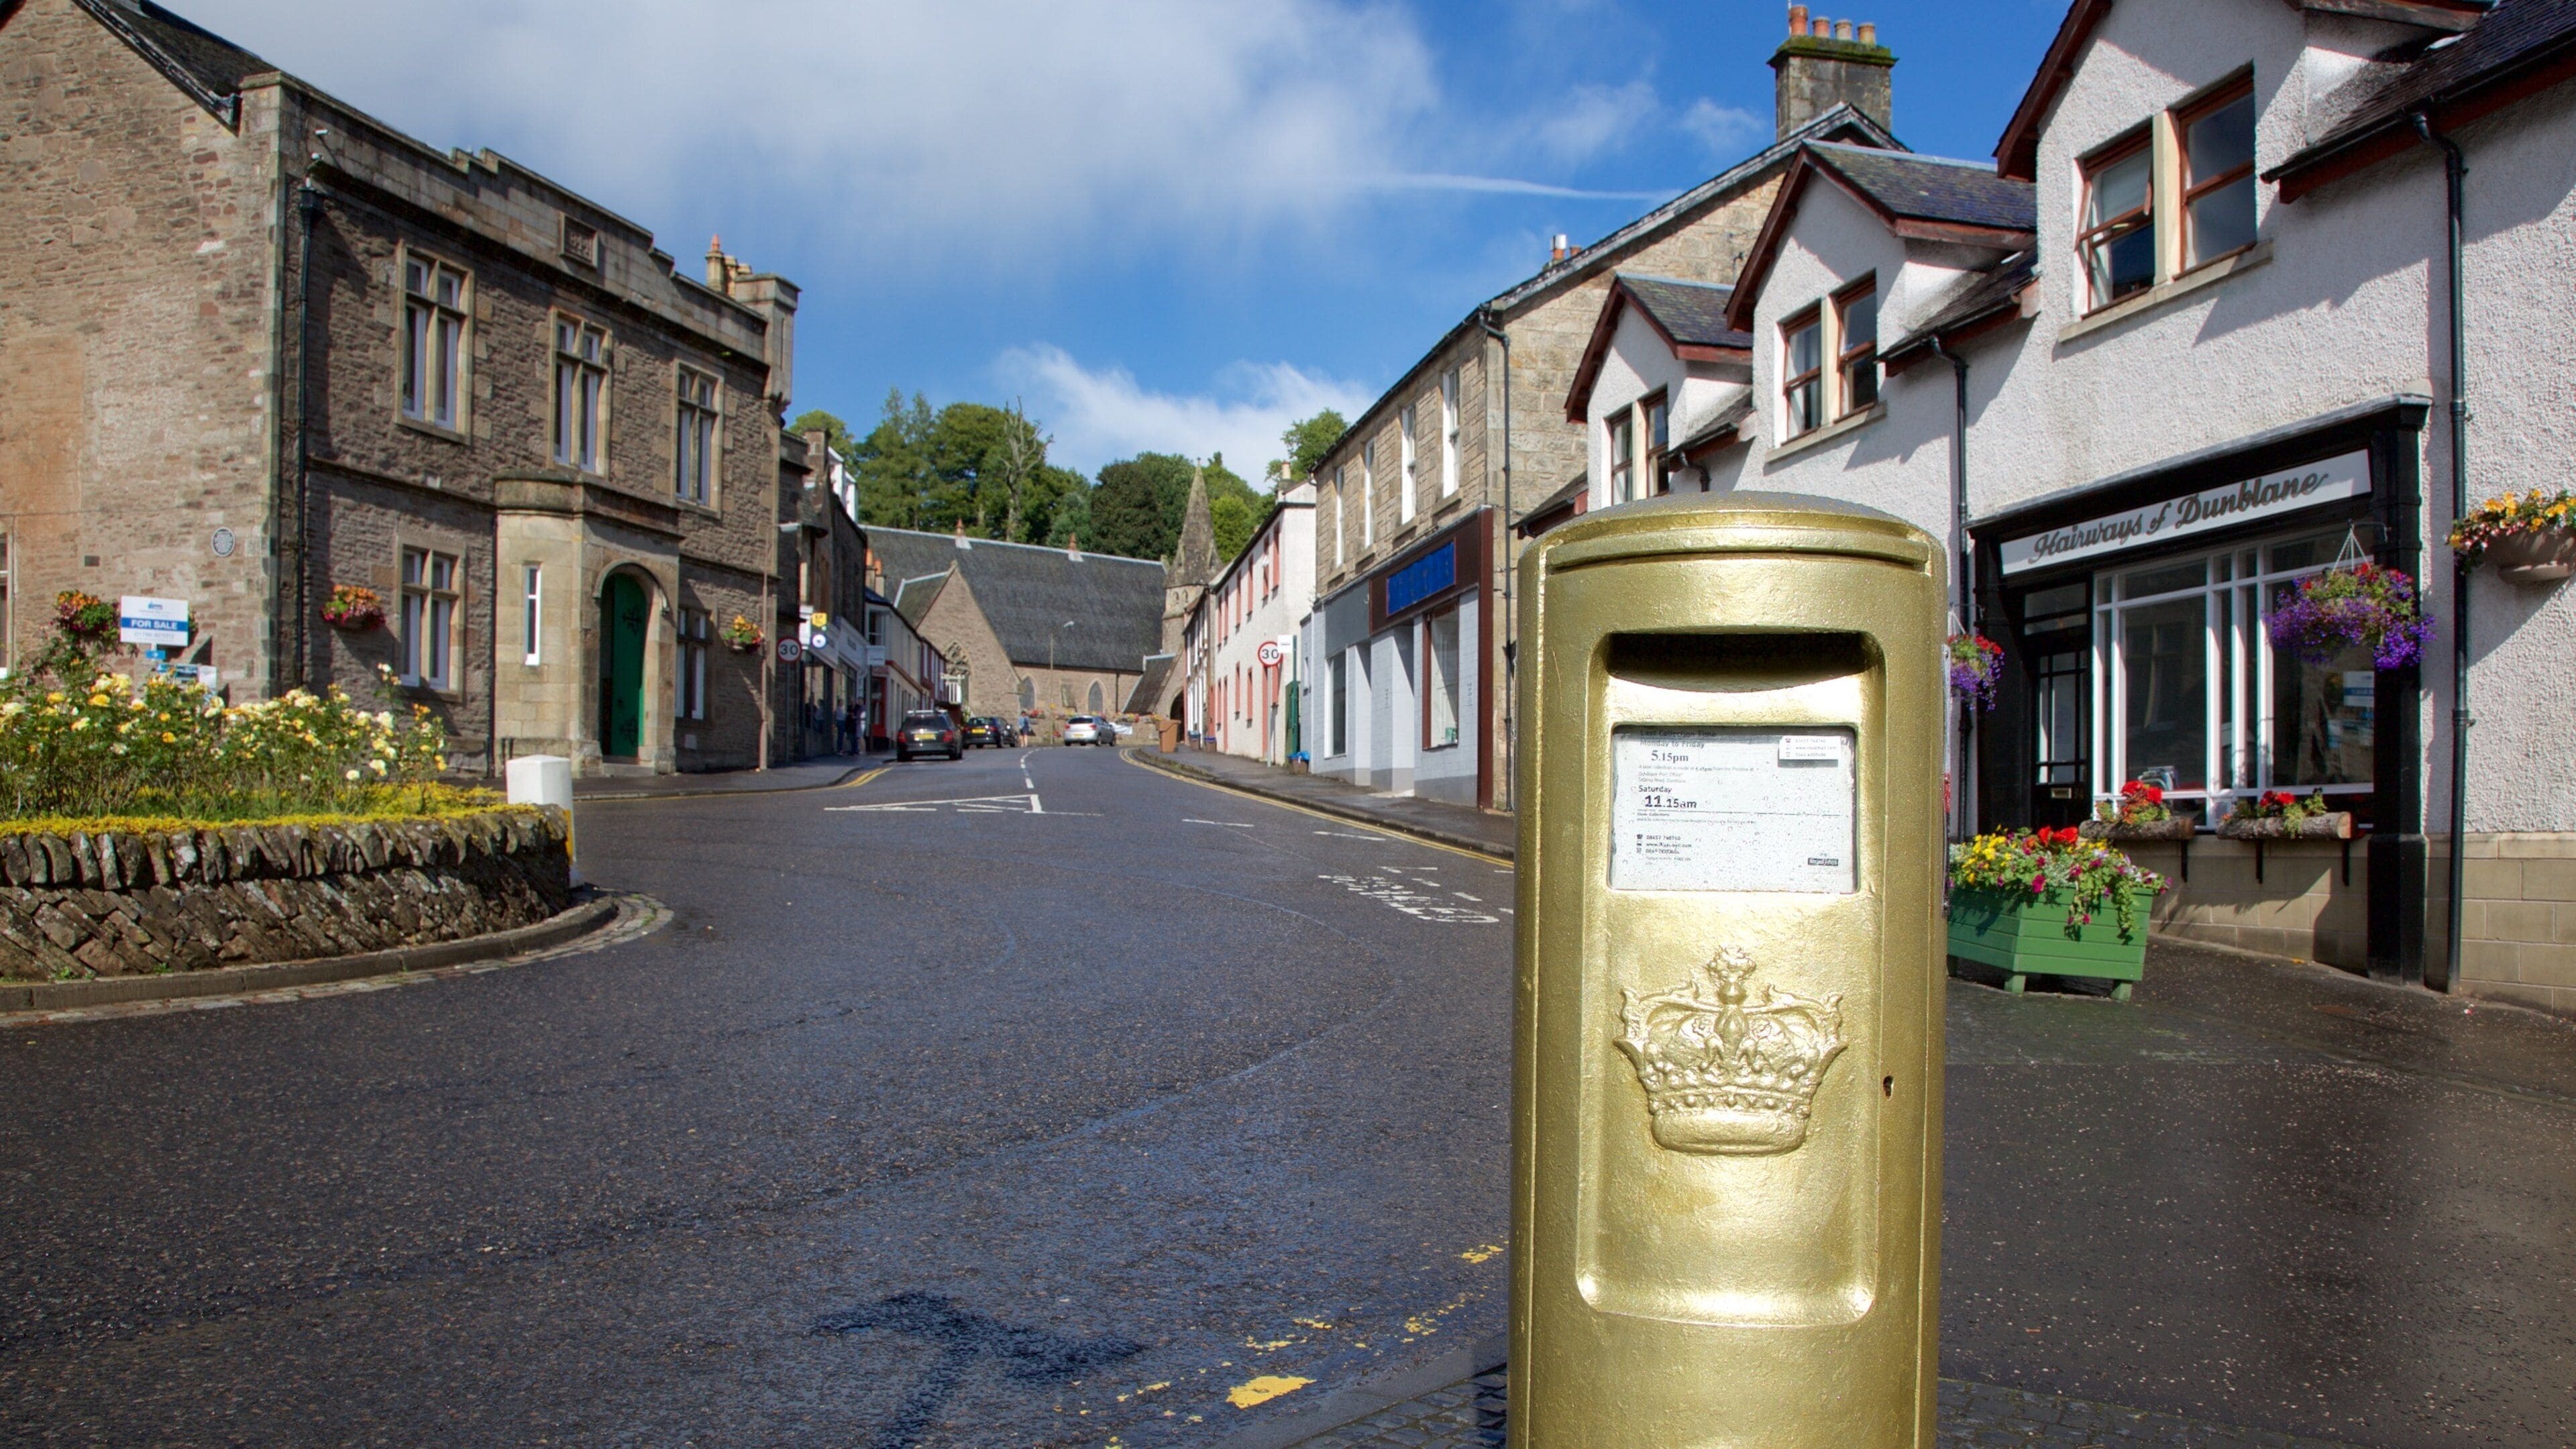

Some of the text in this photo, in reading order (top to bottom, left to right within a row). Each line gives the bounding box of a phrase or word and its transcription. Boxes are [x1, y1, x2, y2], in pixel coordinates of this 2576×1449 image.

[2027, 472, 2328, 564] Hairways of Dunblane
[131, 619, 178, 631] FOR SALE
[780, 644, 798, 655] 30
[1262, 649, 1279, 659] 30
[1658, 729, 1695, 737] Collection
[1640, 739, 1669, 747] Monday
[1682, 741, 1705, 749] Friday
[1651, 750, 1689, 763] 5.15pm
[1638, 785, 1672, 794] Saturday
[1644, 795, 1697, 808] 11.15am
